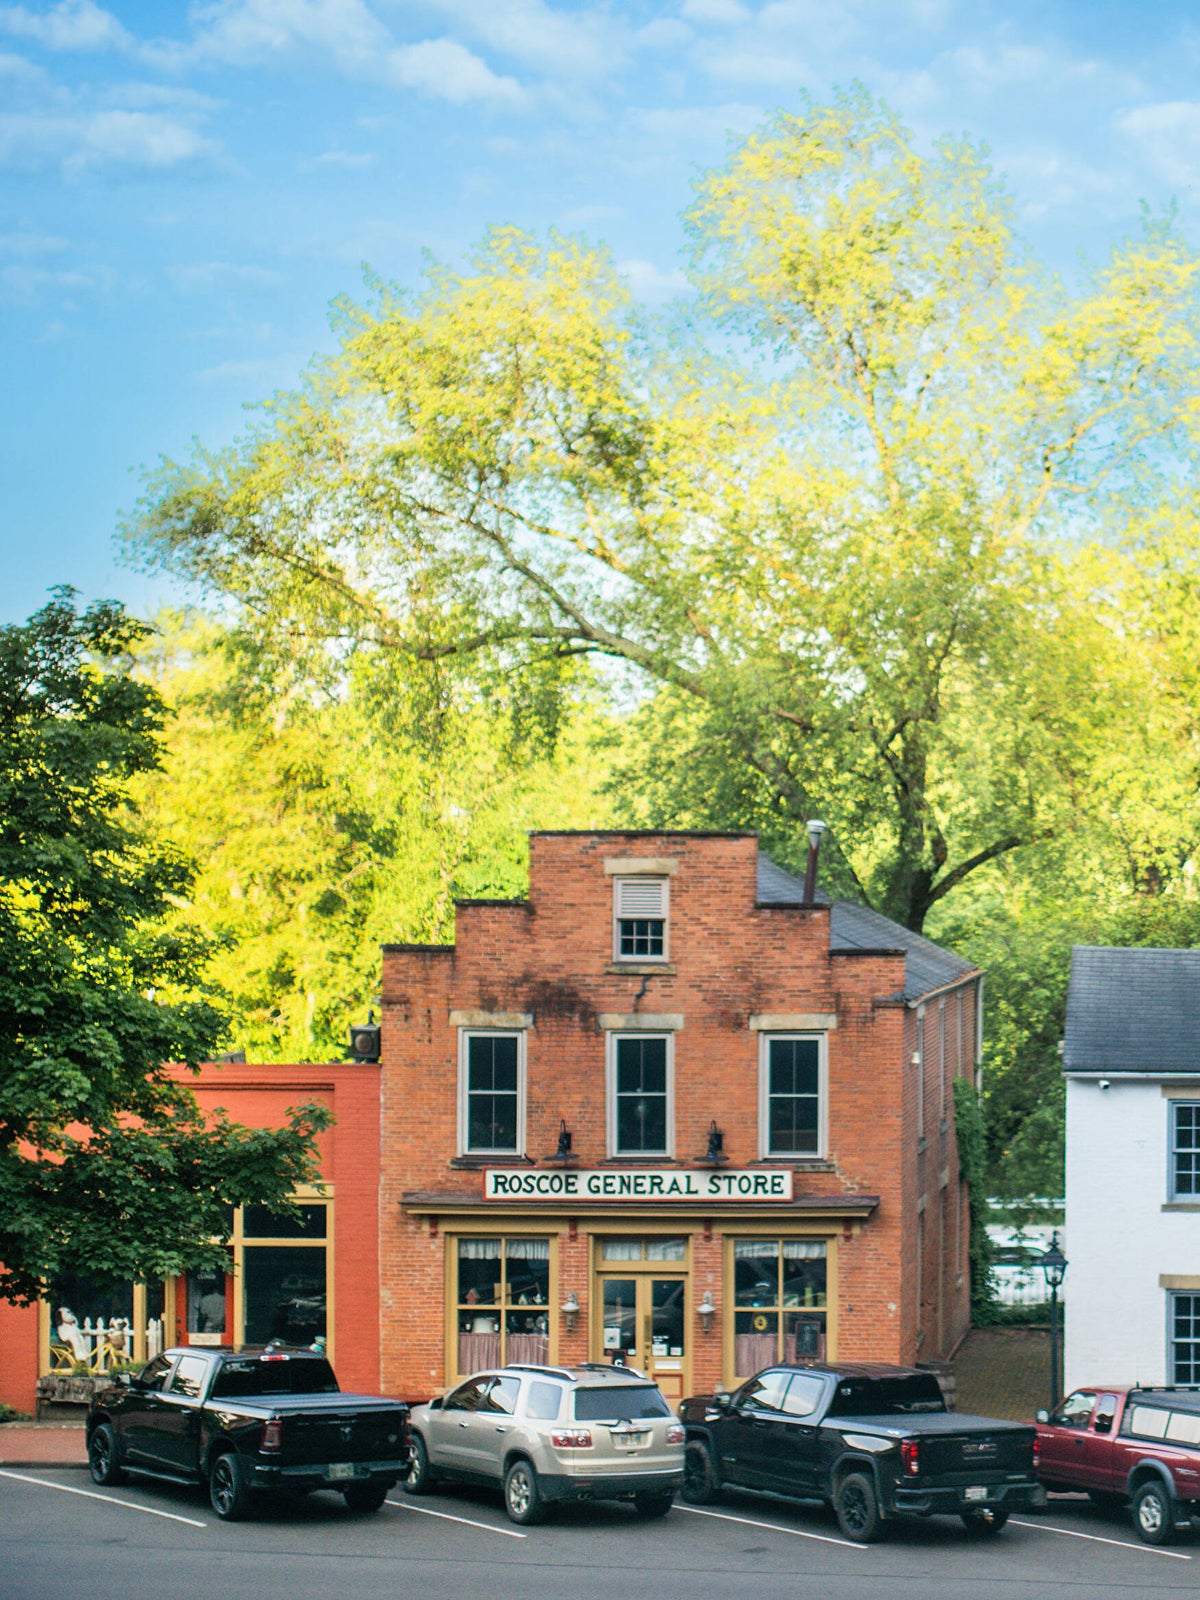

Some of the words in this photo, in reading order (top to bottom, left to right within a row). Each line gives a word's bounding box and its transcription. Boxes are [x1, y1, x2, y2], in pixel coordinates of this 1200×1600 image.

[492, 1174, 578, 1194] ROSCOE
[587, 1174, 699, 1195] GENERAL
[708, 1174, 784, 1195] STORE
